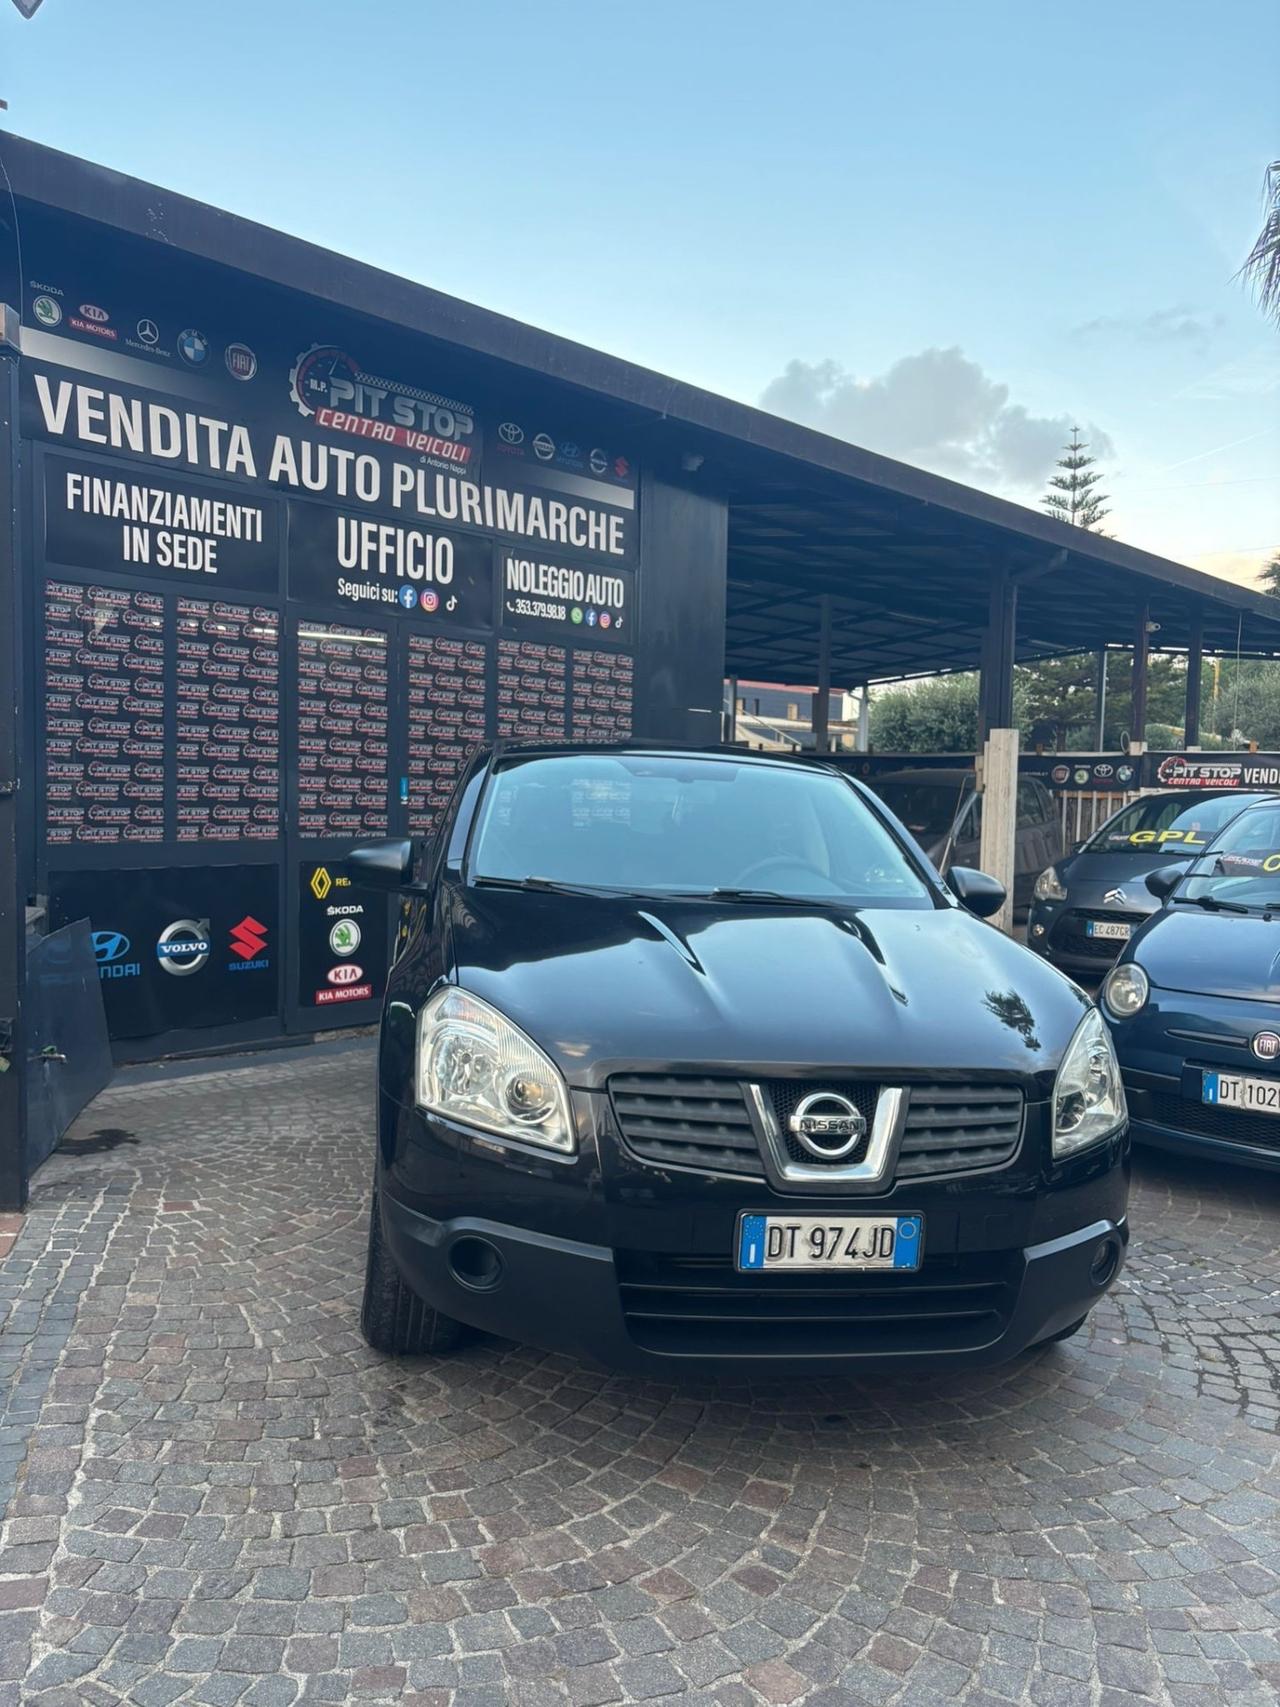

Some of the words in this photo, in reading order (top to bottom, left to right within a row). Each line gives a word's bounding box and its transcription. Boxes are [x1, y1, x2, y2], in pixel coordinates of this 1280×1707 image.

[84, 306, 105, 320] KIA
[72, 319, 84, 328] KIA
[85, 324, 115, 337] MOTORS
[232, 352, 250, 371] FIAT
[329, 376, 388, 417] PIT
[392, 396, 474, 441] STOP
[34, 374, 257, 478] VENDITA
[268, 434, 381, 502] AUTO
[393, 462, 625, 555] PLURIMARCHE
[67, 472, 262, 542] FINANZIAMENTI
[123, 525, 149, 564] IN
[156, 531, 217, 574] SEDE
[337, 517, 454, 585] UFFICIO
[337, 577, 380, 602] Seguici
[381, 588, 398, 604] su:
[506, 558, 584, 602] NOLEGGIO
[585, 574, 624, 608] AUTO
[1173, 767, 1197, 777] PIT
[1199, 767, 1241, 778] STOP
[1129, 830, 1206, 844] GPL
[327, 905, 364, 915] ŠKODA
[160, 942, 208, 953] VOLVO
[101, 963, 141, 979] NDAI
[229, 959, 269, 971] SUZUKI
[334, 968, 358, 980] KIA
[319, 990, 334, 1001] KIA
[335, 987, 369, 998] MOTORS
[1260, 1040, 1276, 1053] FIAT
[1221, 1081, 1239, 1101] DT
[1248, 1085, 1280, 1108] 102
[800, 1118, 860, 1131] NISSAN
[768, 1225, 801, 1259] DT
